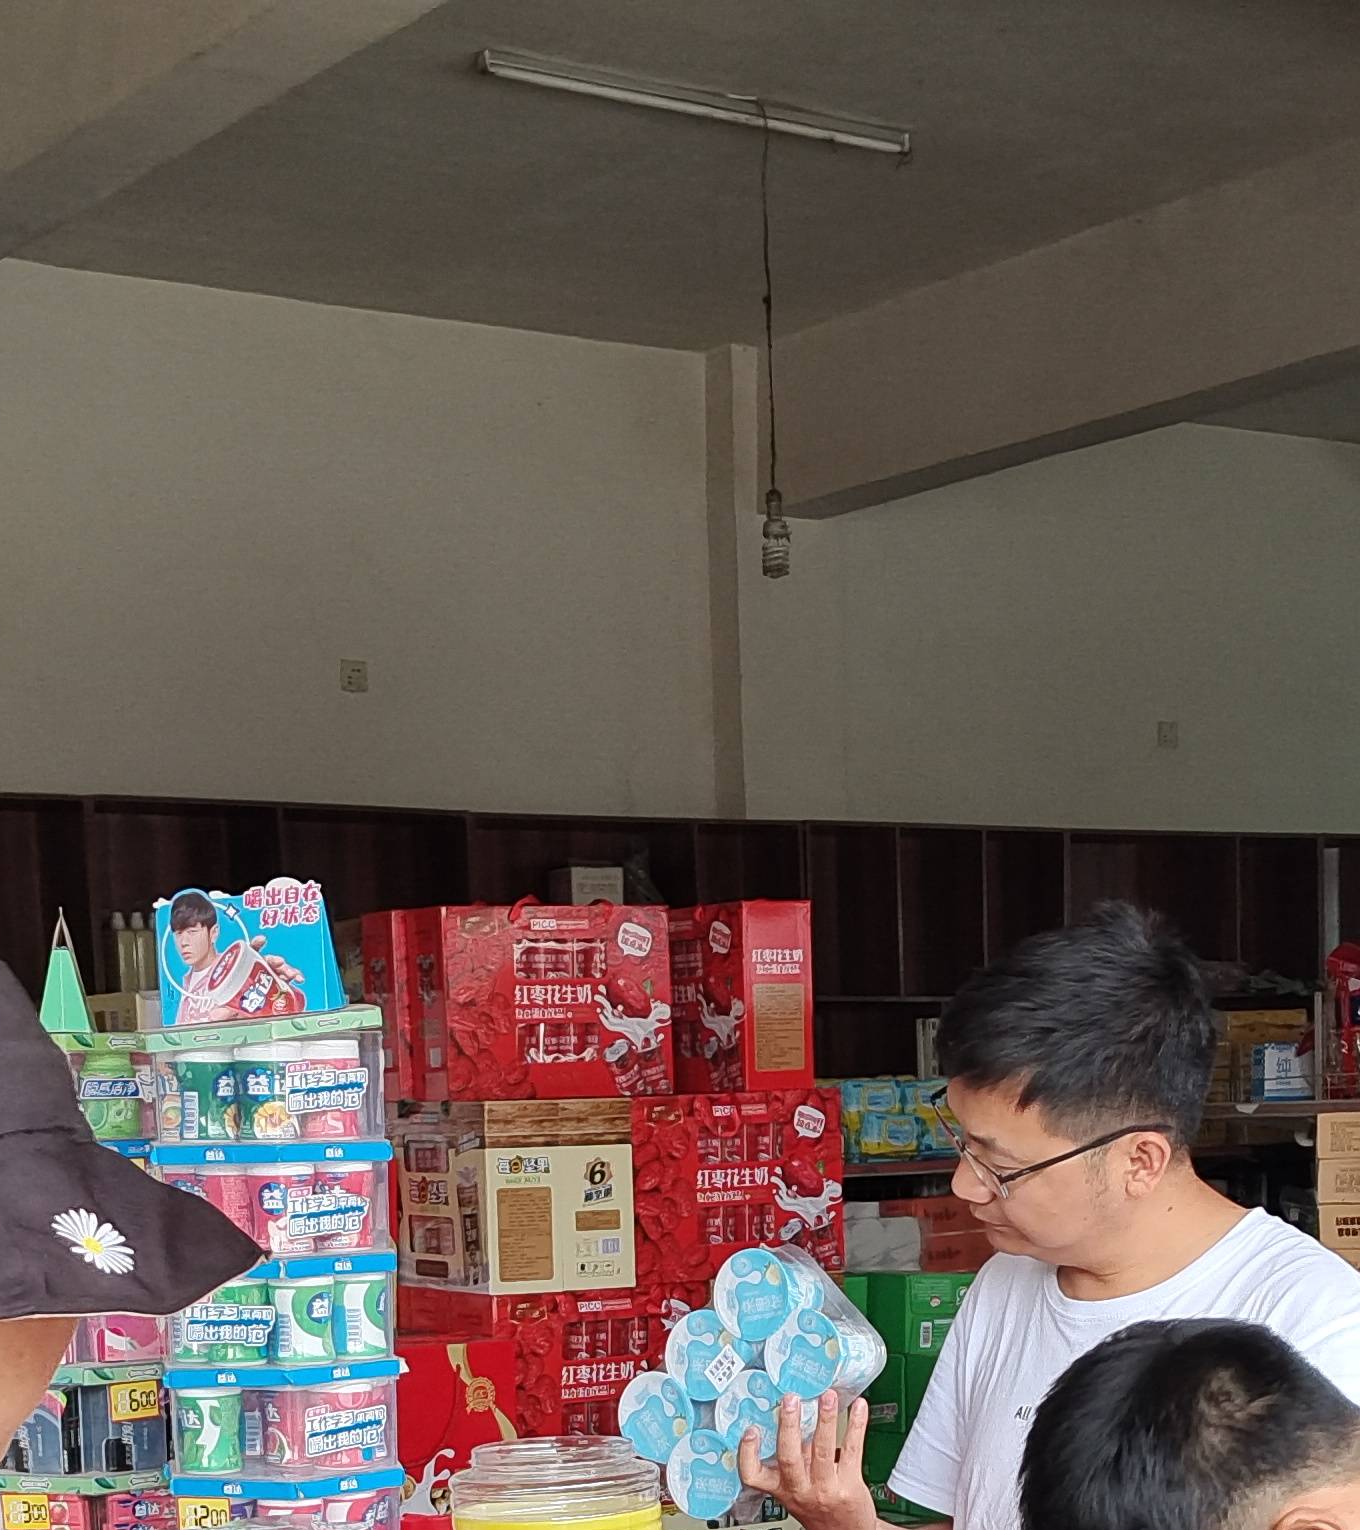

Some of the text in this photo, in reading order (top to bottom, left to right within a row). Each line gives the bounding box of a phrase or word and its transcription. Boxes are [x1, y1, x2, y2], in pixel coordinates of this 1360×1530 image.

[260, 904, 321, 928] 好状态
[532, 919, 556, 930] PICC
[514, 984, 592, 1005] 红枣花生奶
[714, 1105, 735, 1117] PICC
[590, 1161, 606, 1187] 6
[696, 1166, 770, 1188] 红枣花生奶
[578, 1301, 603, 1312] PICC
[561, 1361, 637, 1384] 红枣花生奶
